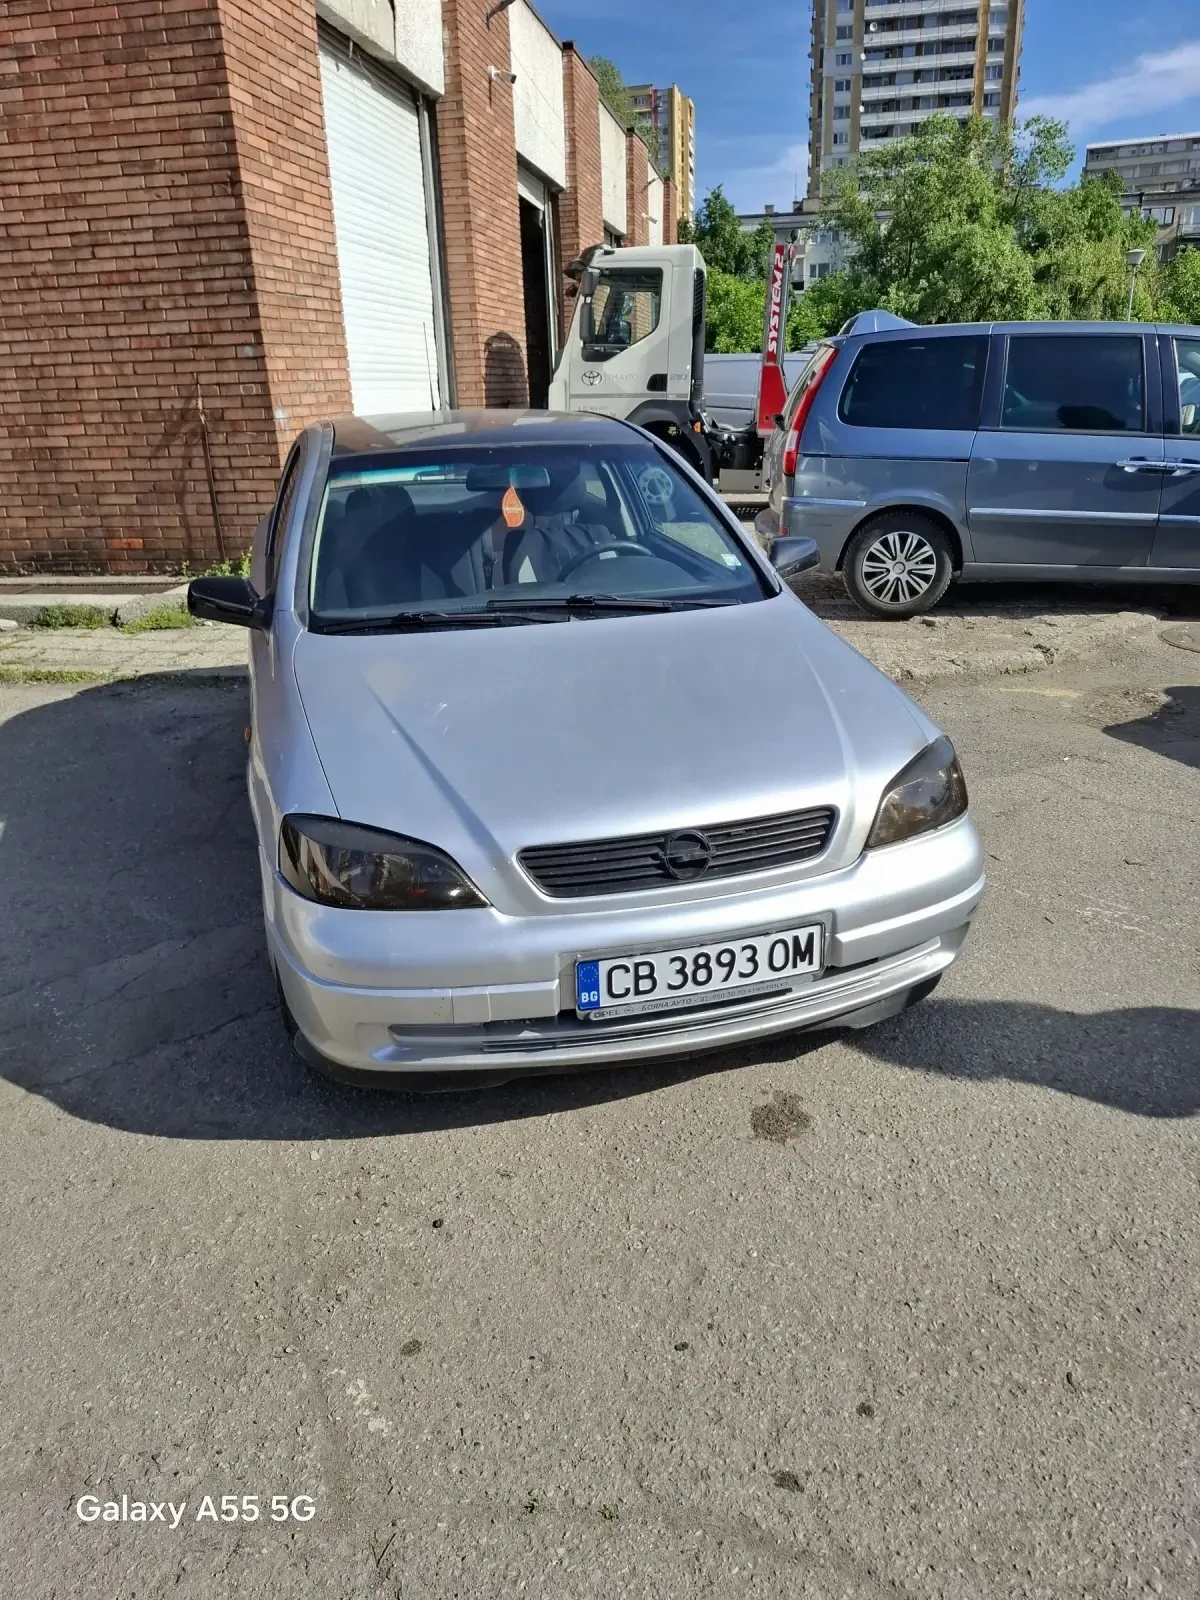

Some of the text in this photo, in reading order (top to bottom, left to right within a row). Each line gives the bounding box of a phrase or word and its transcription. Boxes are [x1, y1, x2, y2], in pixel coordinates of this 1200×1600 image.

[768, 269, 783, 355] SYSTEM
[581, 991, 598, 1003] BG
[607, 931, 815, 999] CB 3893 OM
